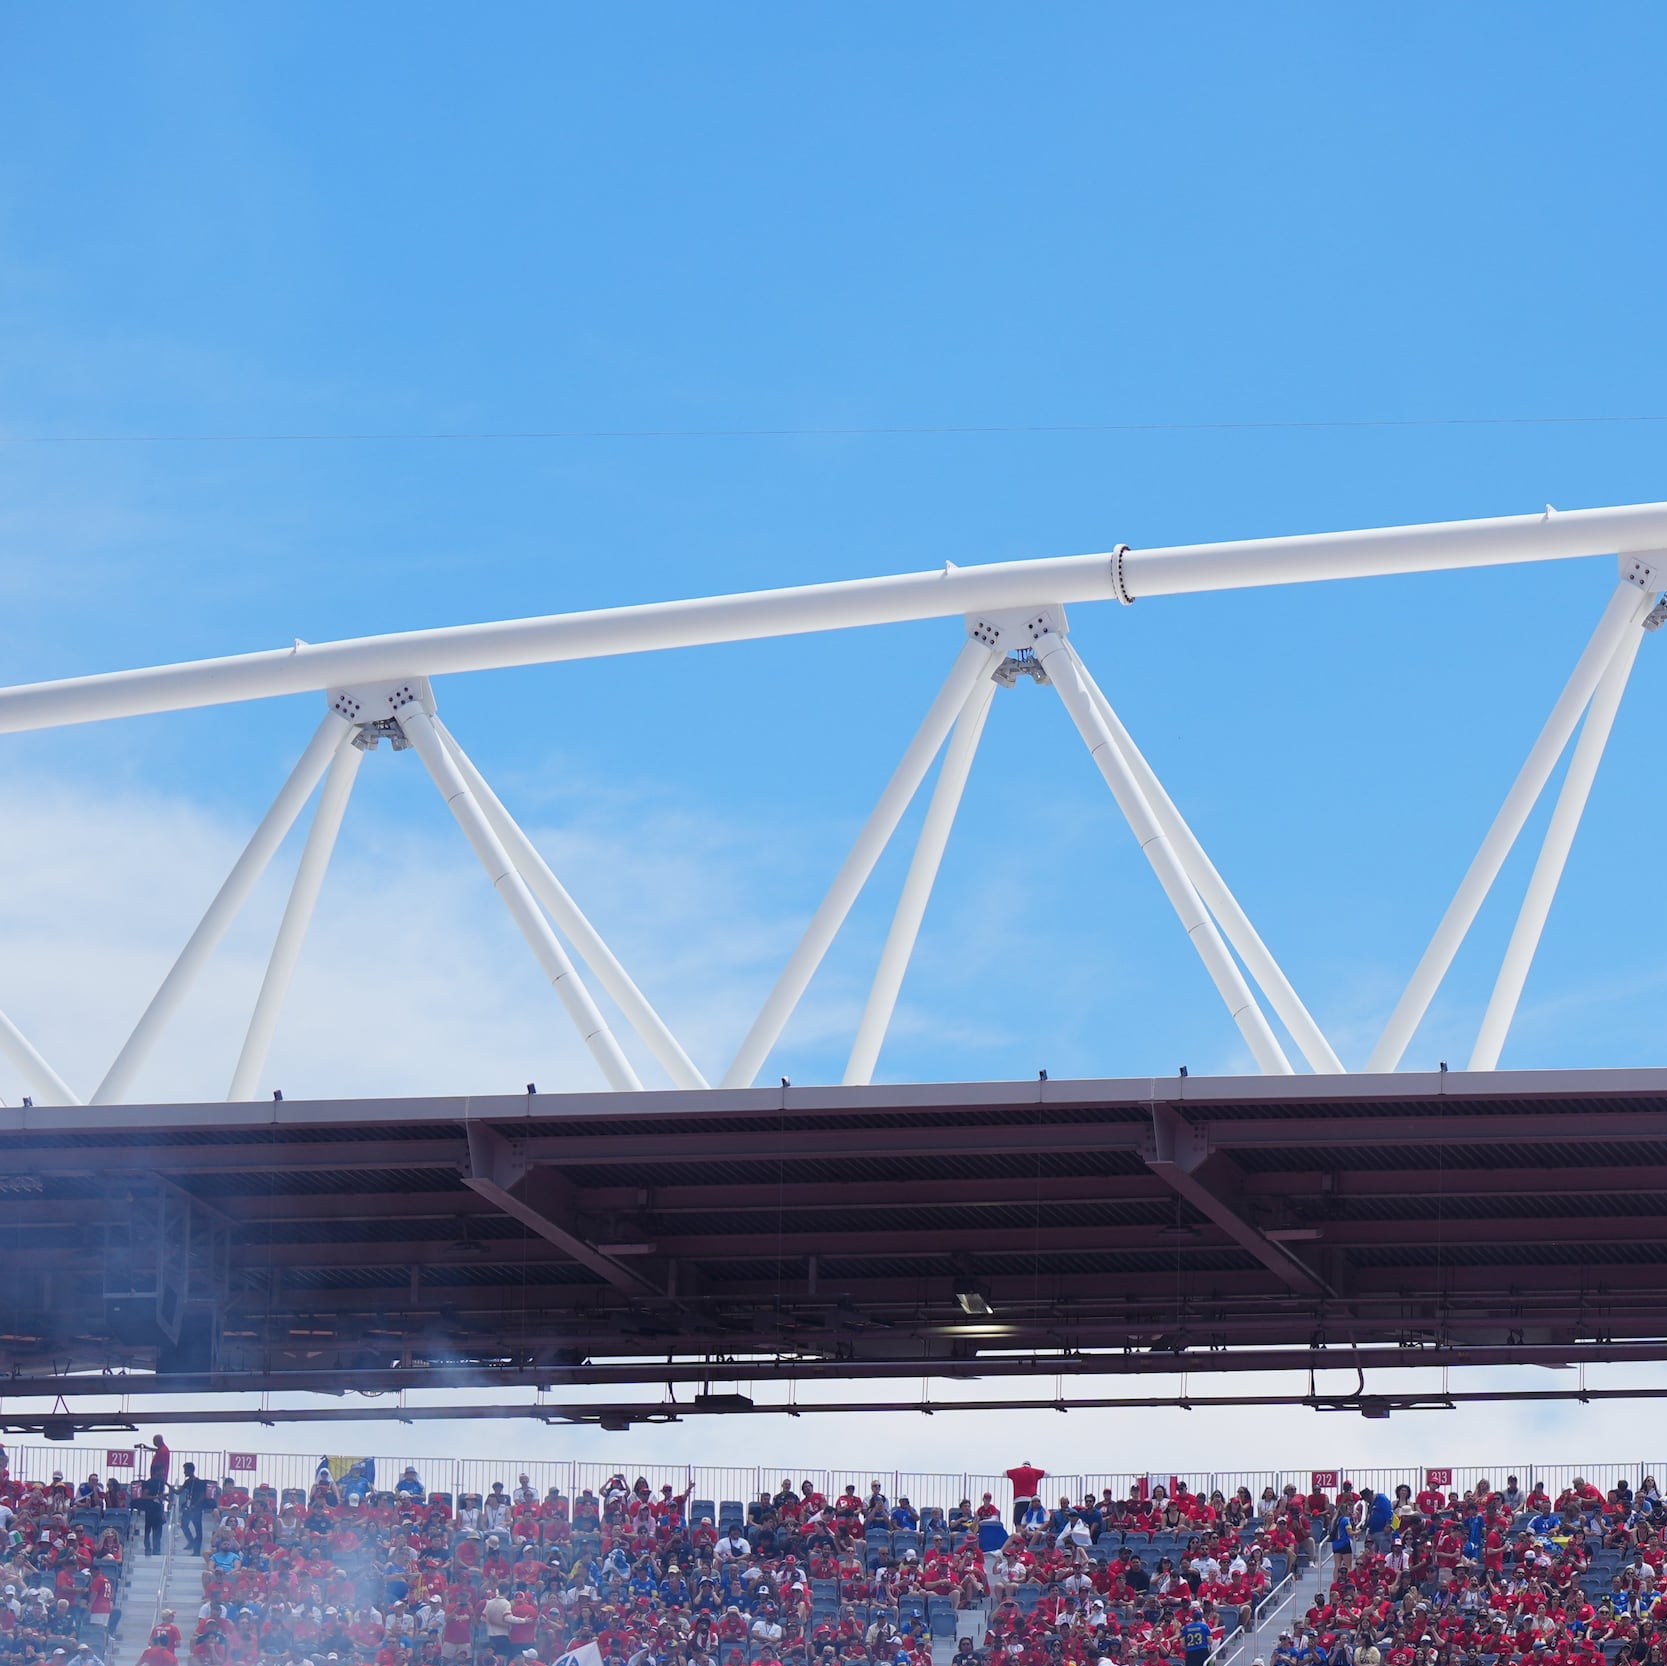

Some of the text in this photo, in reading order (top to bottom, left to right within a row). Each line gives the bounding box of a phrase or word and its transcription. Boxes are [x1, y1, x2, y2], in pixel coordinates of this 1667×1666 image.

[112, 1452, 129, 1465] 212
[235, 1456, 252, 1469] 212
[1316, 1473, 1332, 1487] 212
[1187, 1632, 1203, 1645] 23
